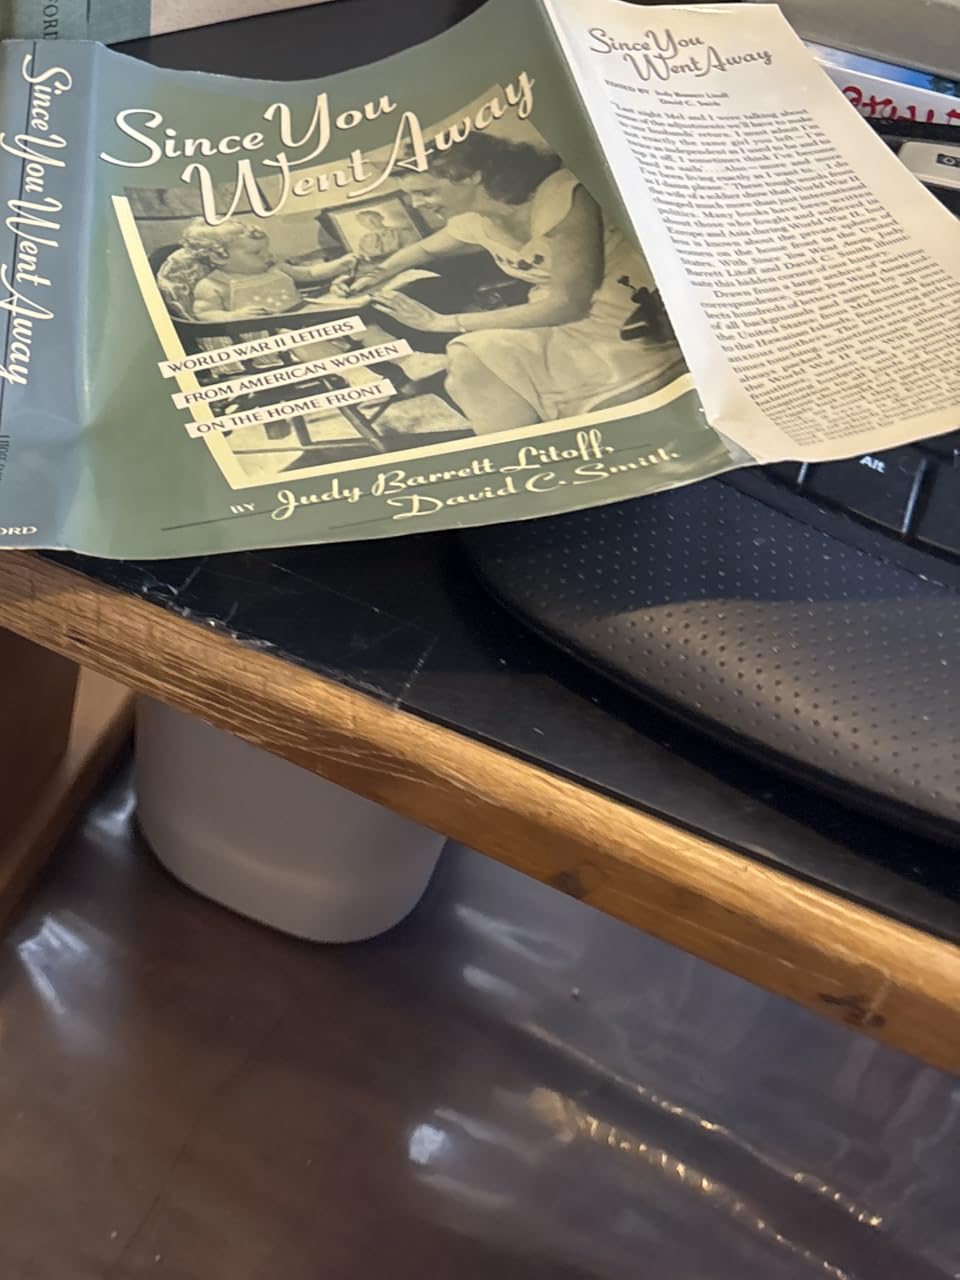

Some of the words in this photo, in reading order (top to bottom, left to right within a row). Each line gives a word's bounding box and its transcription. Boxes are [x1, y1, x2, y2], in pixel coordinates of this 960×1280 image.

[588, 27, 650, 55] Since
[646, 28, 704, 60] You
[623, 52, 702, 82] Went
[695, 45, 773, 78] Away
[22, 53, 73, 131] Since
[99, 108, 265, 168] Since
[263, 92, 397, 166] You
[181, 152, 373, 226] Went
[347, 70, 535, 199] Away
[5, 197, 63, 287] Went
[167, 350, 231, 373] WORLD
[232, 341, 272, 358] WAR
[275, 338, 287, 349] II
[290, 321, 354, 345] LETTERS
[184, 384, 235, 405] FROM
[239, 361, 327, 392] AMERICAN
[332, 344, 400, 368] WOMEN
[196, 420, 226, 434] ON
[231, 411, 264, 428] THE
[266, 399, 322, 419] HOME
[325, 384, 384, 406] FRONT
[229, 501, 256, 515] BY
[271, 480, 363, 521] Judy
[371, 457, 496, 496] Barrett
[392, 477, 518, 521] David
[524, 471, 567, 493] C.
[571, 447, 680, 486] Smith
[860, 455, 886, 473] Alt
